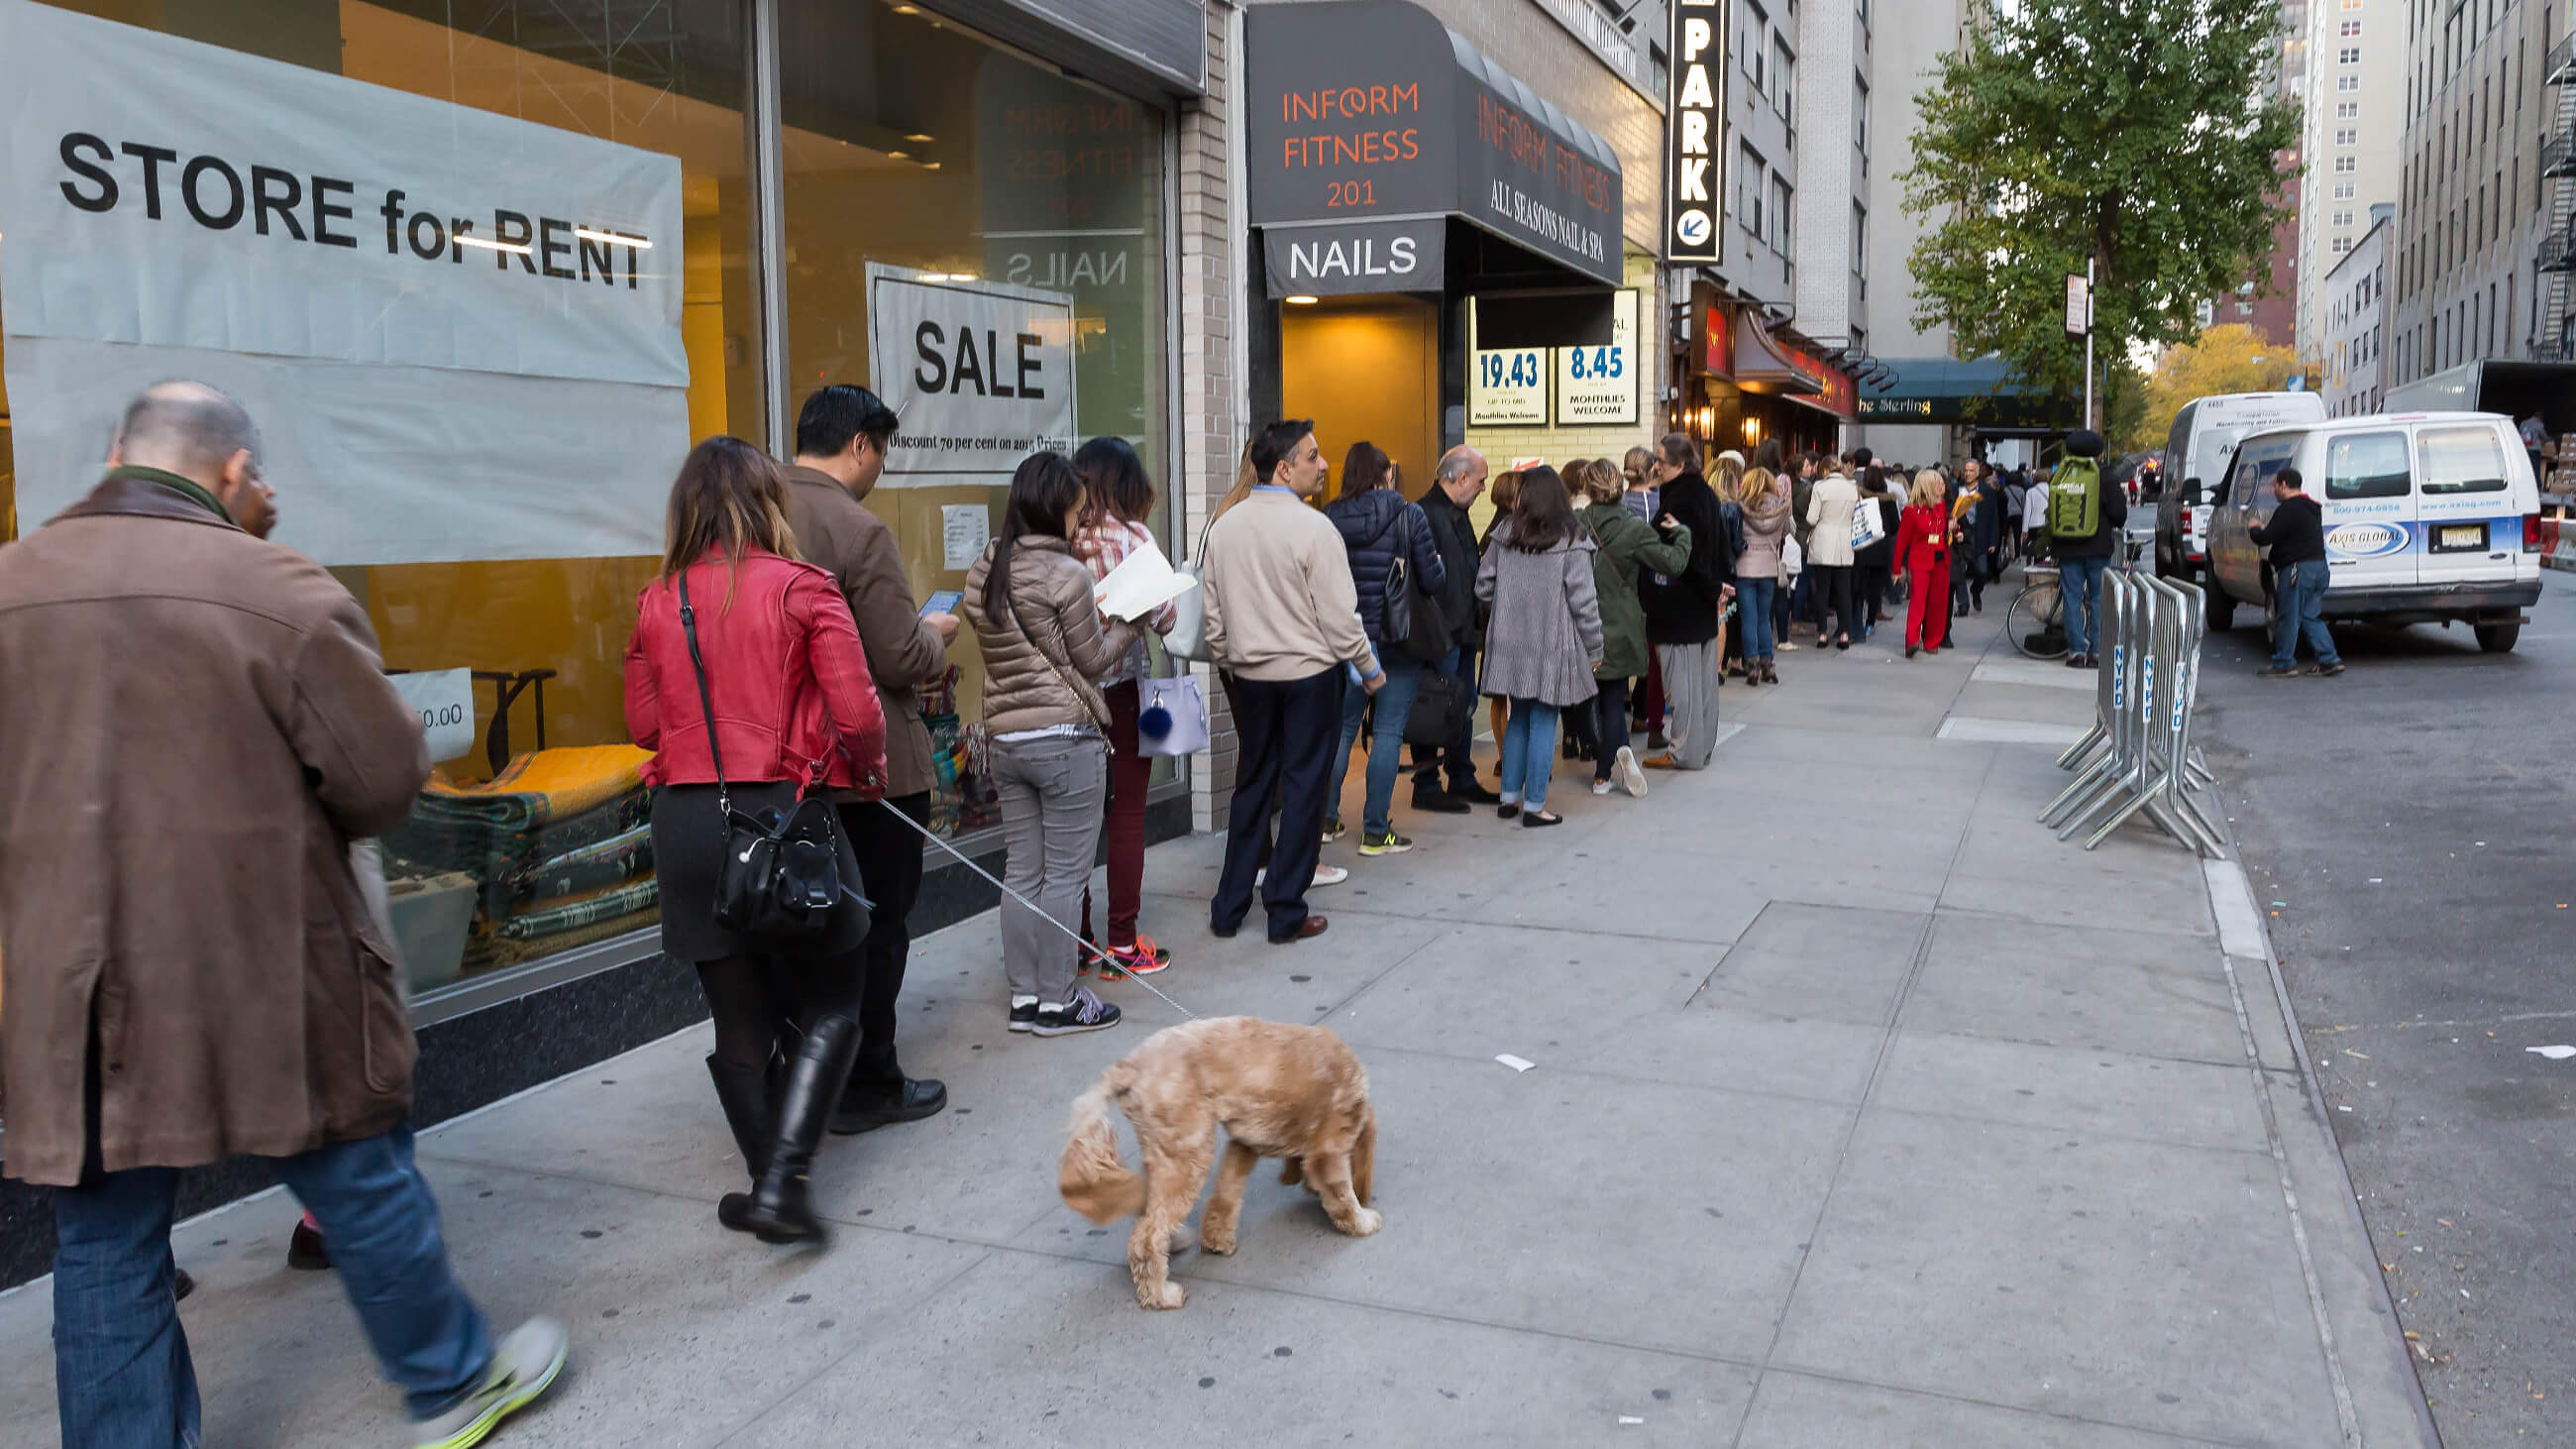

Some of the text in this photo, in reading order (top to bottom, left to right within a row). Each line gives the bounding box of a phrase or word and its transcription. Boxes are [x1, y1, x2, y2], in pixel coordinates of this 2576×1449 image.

[1283, 82, 1419, 122] INFORM
[1679, 18, 1713, 201] PARK
[1285, 129, 1419, 167] FITNESS
[1477, 93, 1610, 213] INFORM FITNESS
[59, 132, 649, 289] STORE for RENT
[1327, 181, 1376, 207] 201
[1490, 176, 1603, 264] ALL SEASONS NAIL & SPA
[1290, 237, 1417, 278] NAILS
[914, 320, 1044, 399] SALE
[1480, 353, 1537, 388] 19.43
[1571, 346, 1622, 379] 8.45
[1573, 405, 1622, 414] WELCOME
[1859, 397, 1875, 412] he
[889, 432, 937, 449] Discount
[941, 437, 954, 452] 70
[955, 437, 972, 452] per
[975, 436, 997, 449] cent
[1000, 438, 1011, 449] on
[2329, 531, 2354, 547] AXIS
[2359, 530, 2401, 542] GLOBAL
[418, 704, 462, 727] 0.00
